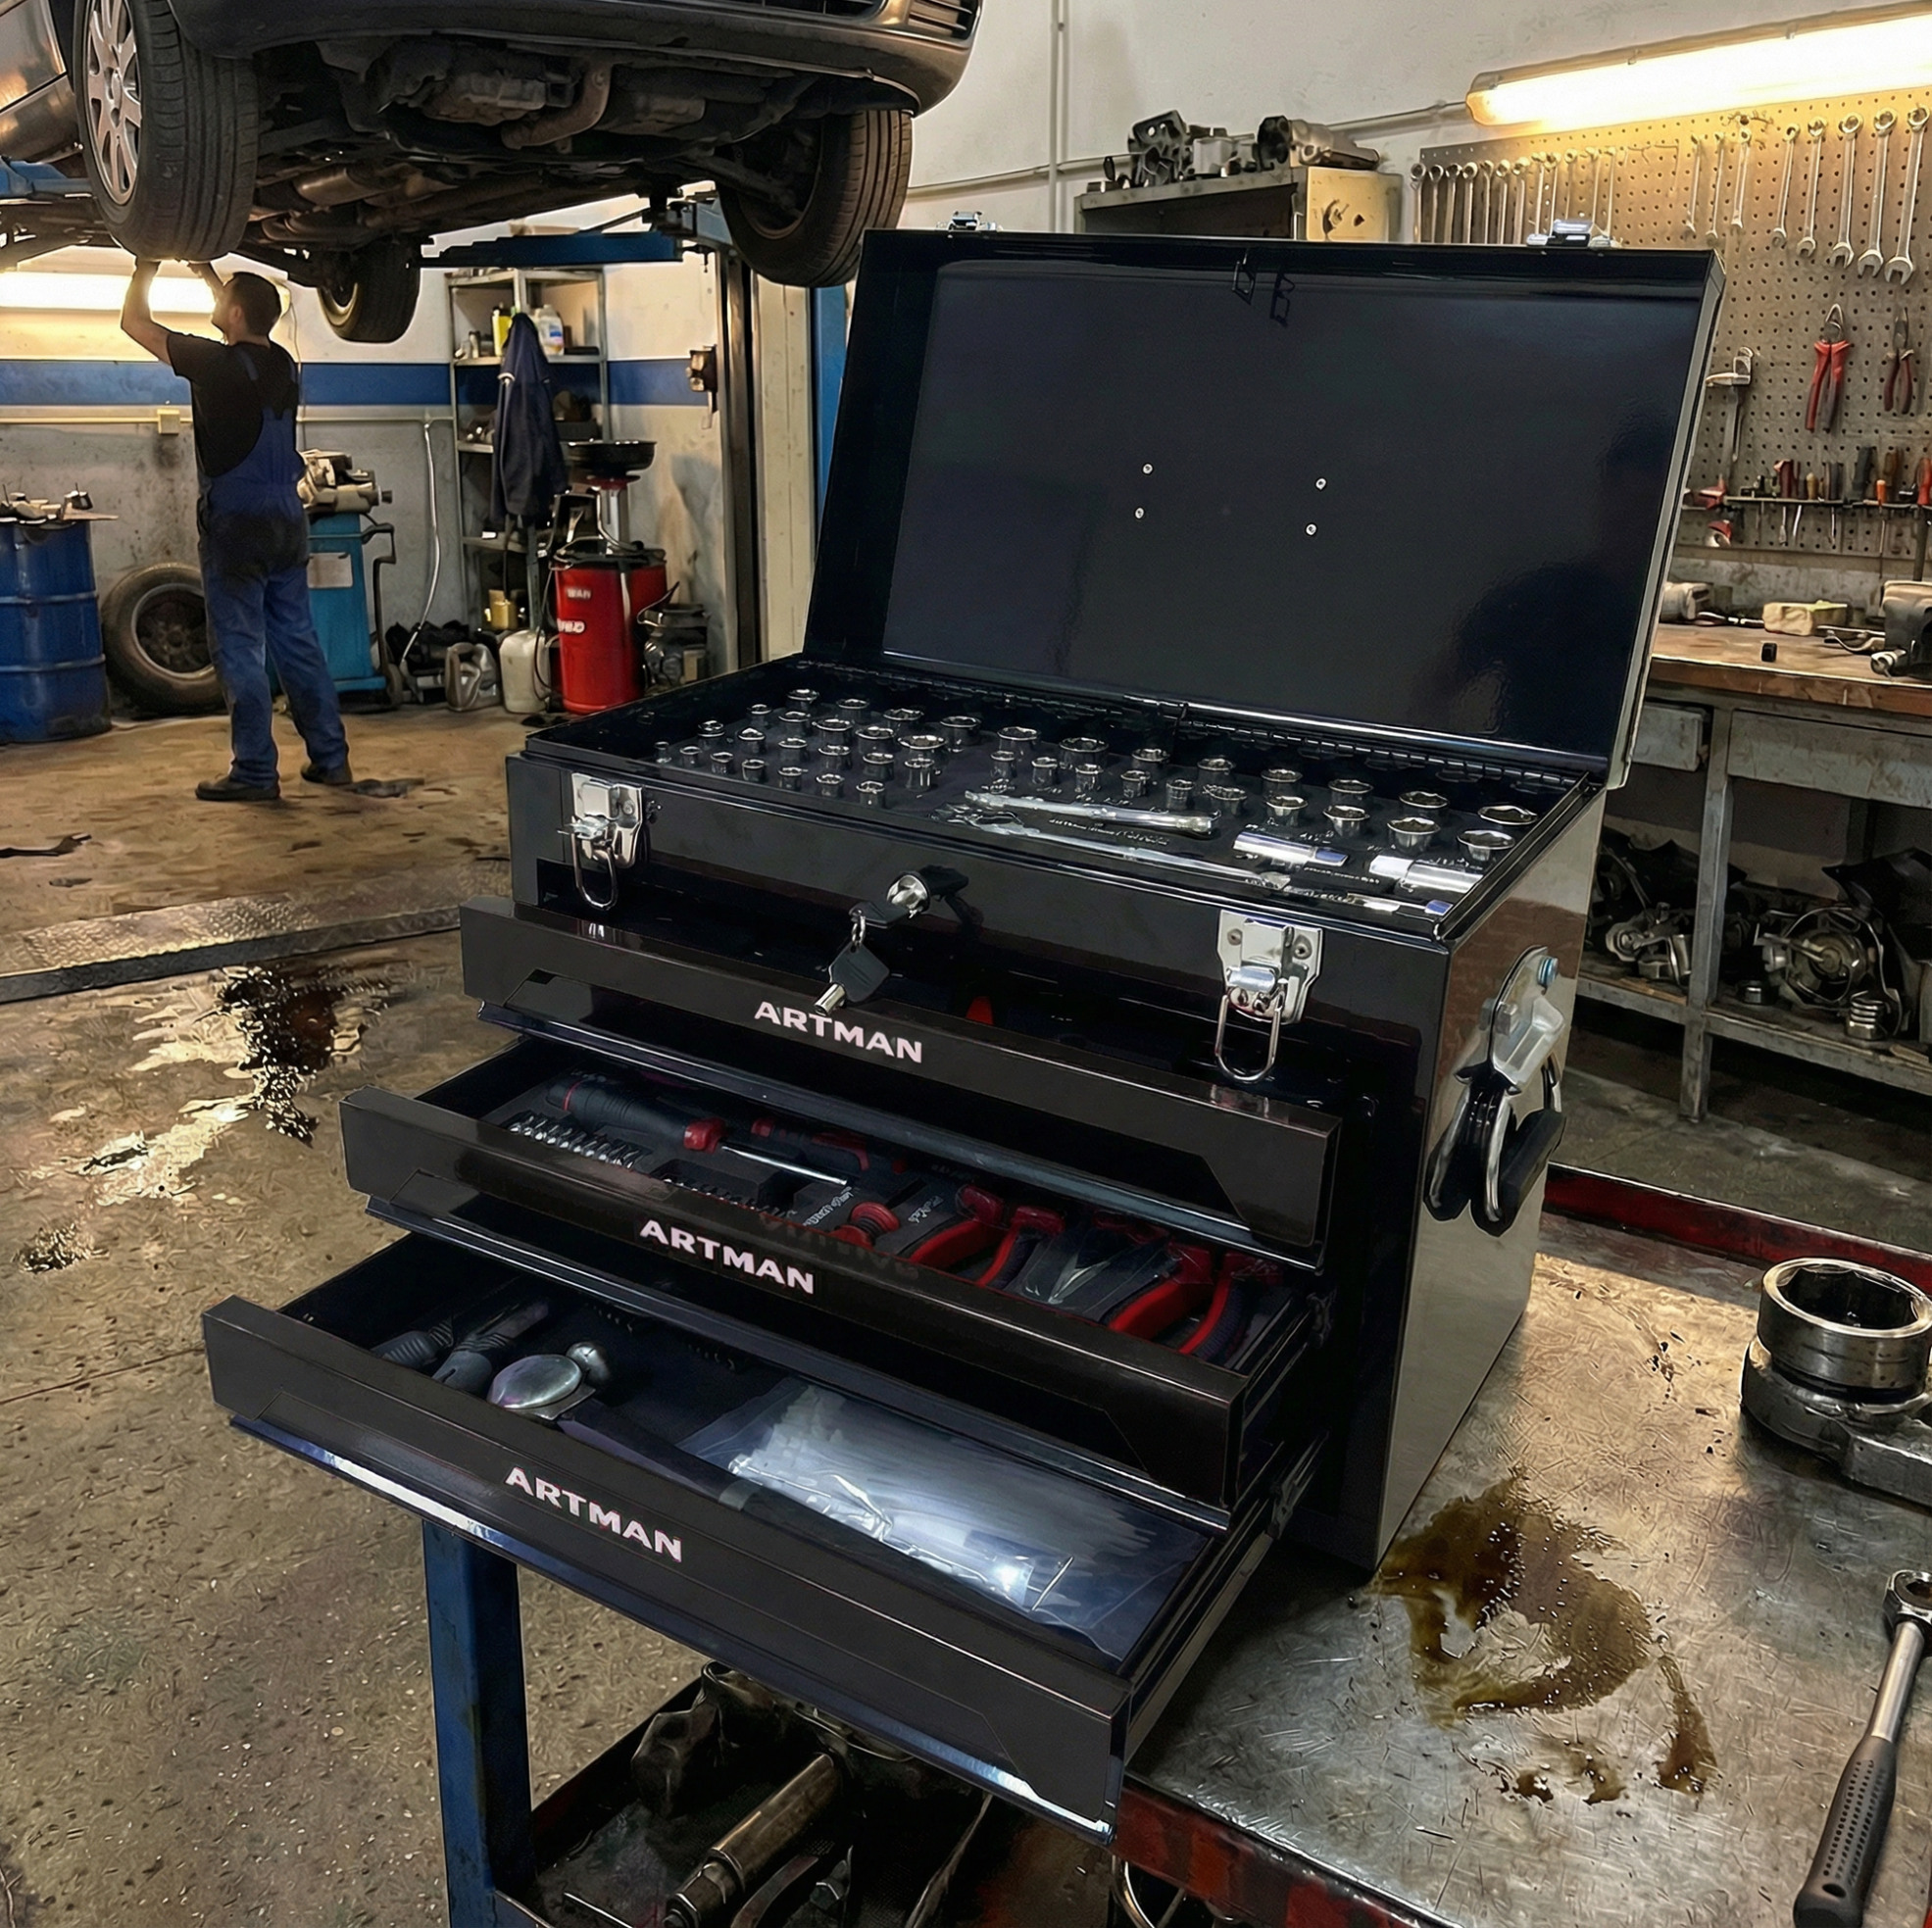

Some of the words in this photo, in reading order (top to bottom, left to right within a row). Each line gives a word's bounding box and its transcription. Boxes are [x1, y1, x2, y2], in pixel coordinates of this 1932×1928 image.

[754, 1001, 922, 1063] ARTMAN
[639, 1219, 814, 1294] ARTMAN
[505, 1466, 682, 1562] ARTMAN
